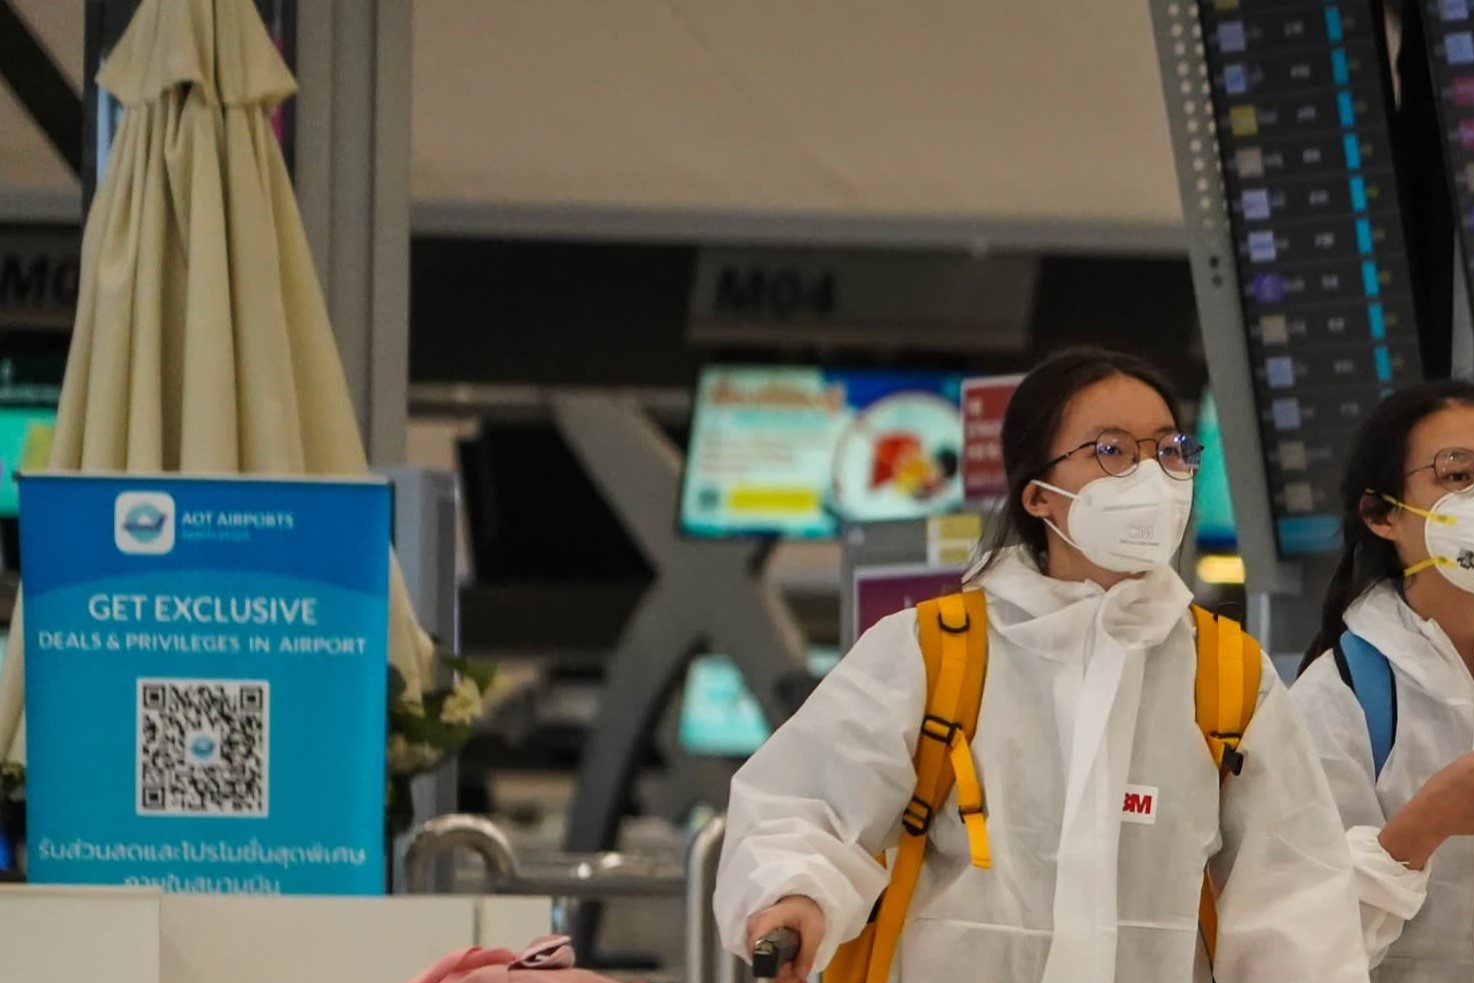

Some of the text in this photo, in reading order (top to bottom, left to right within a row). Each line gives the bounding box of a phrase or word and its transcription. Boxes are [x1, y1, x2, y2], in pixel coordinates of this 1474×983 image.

[217, 511, 294, 528] AIRPORTS
[88, 593, 317, 625] GET EXCLUSIVE
[38, 631, 366, 654] DEALS & PRIVILEGES IN AIRPORT
[1122, 791, 1153, 815] 3M
